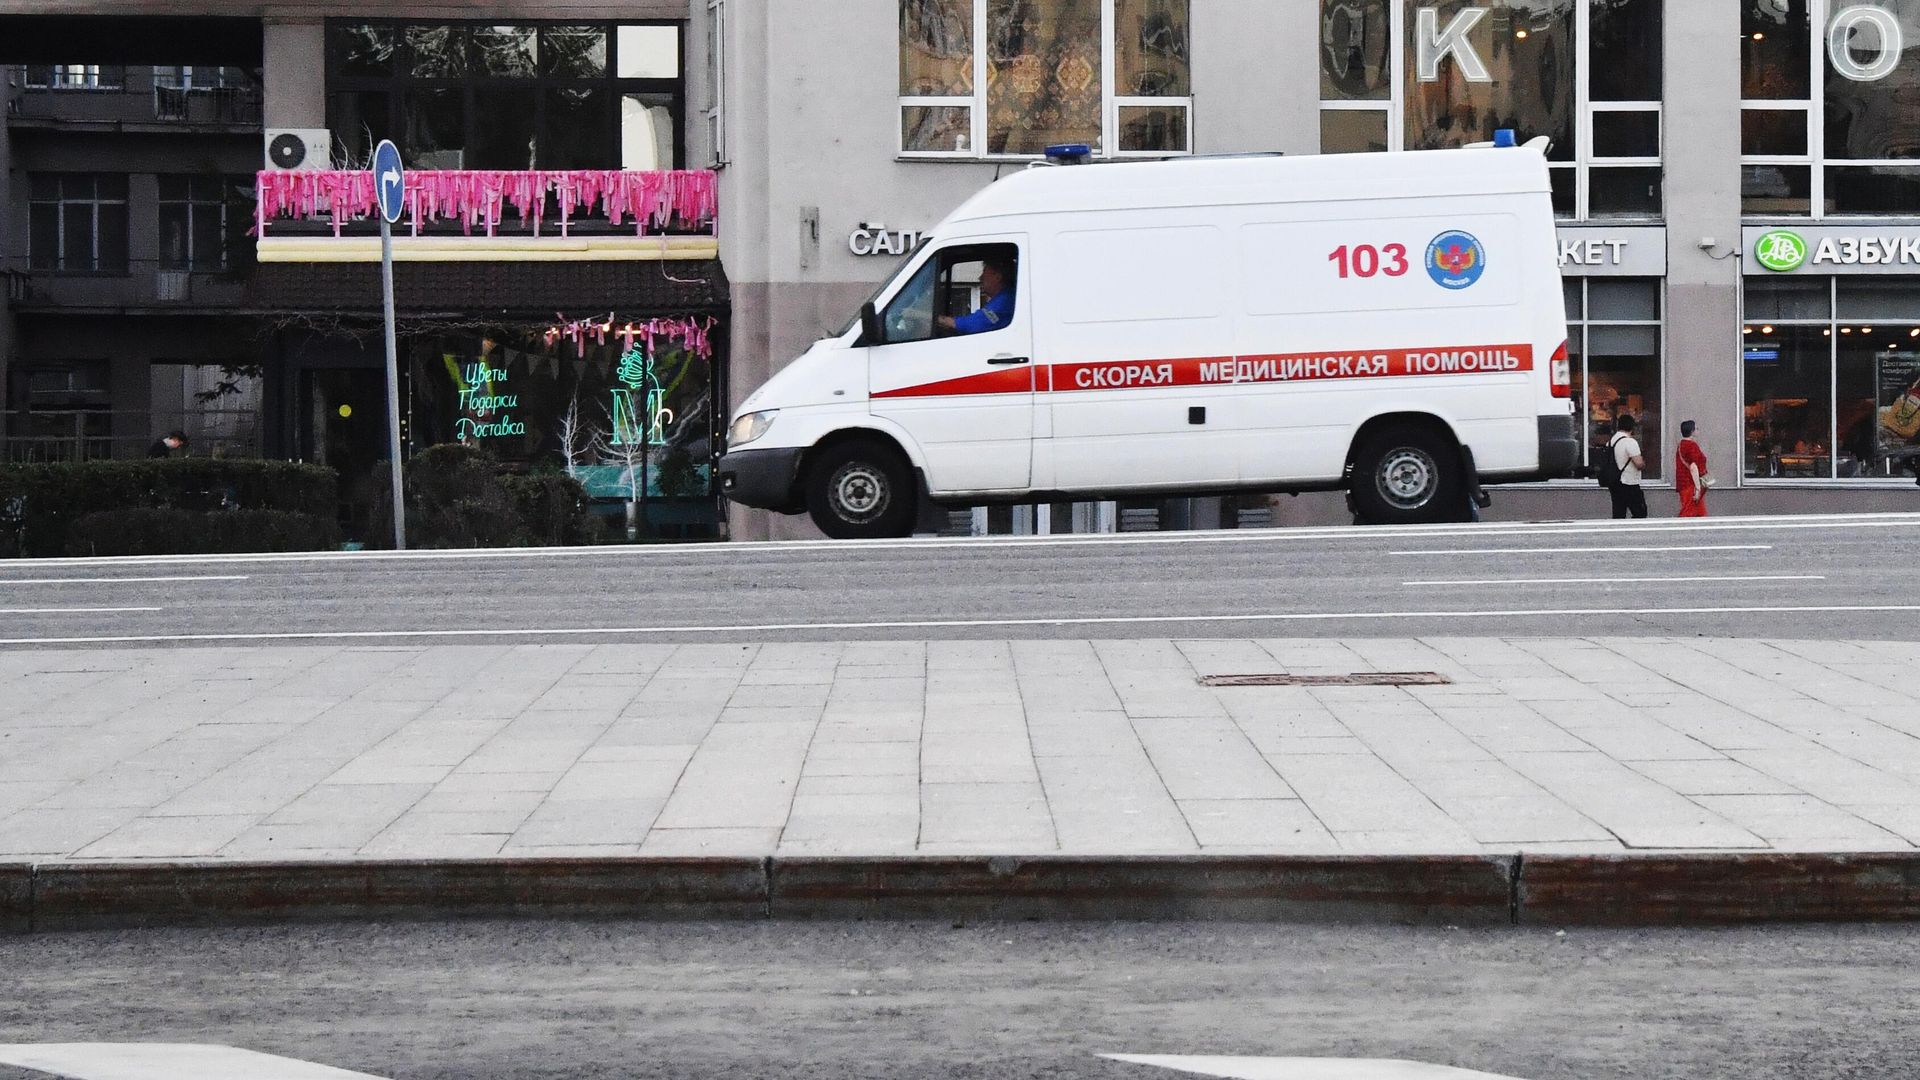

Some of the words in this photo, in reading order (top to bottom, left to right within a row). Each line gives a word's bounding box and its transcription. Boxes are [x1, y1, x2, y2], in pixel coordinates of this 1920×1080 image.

[849, 229, 931, 255] САЛ
[1328, 243, 1409, 278] 103
[466, 362, 508, 390] Цветы
[1075, 364, 1174, 388] СКОРАЯ
[1200, 355, 1388, 383] МЕДИЦИНСКАЯ
[1405, 350, 1519, 372] ПОМОЩЬ
[458, 389, 518, 417] Подарки
[455, 415, 526, 439] Доставка
